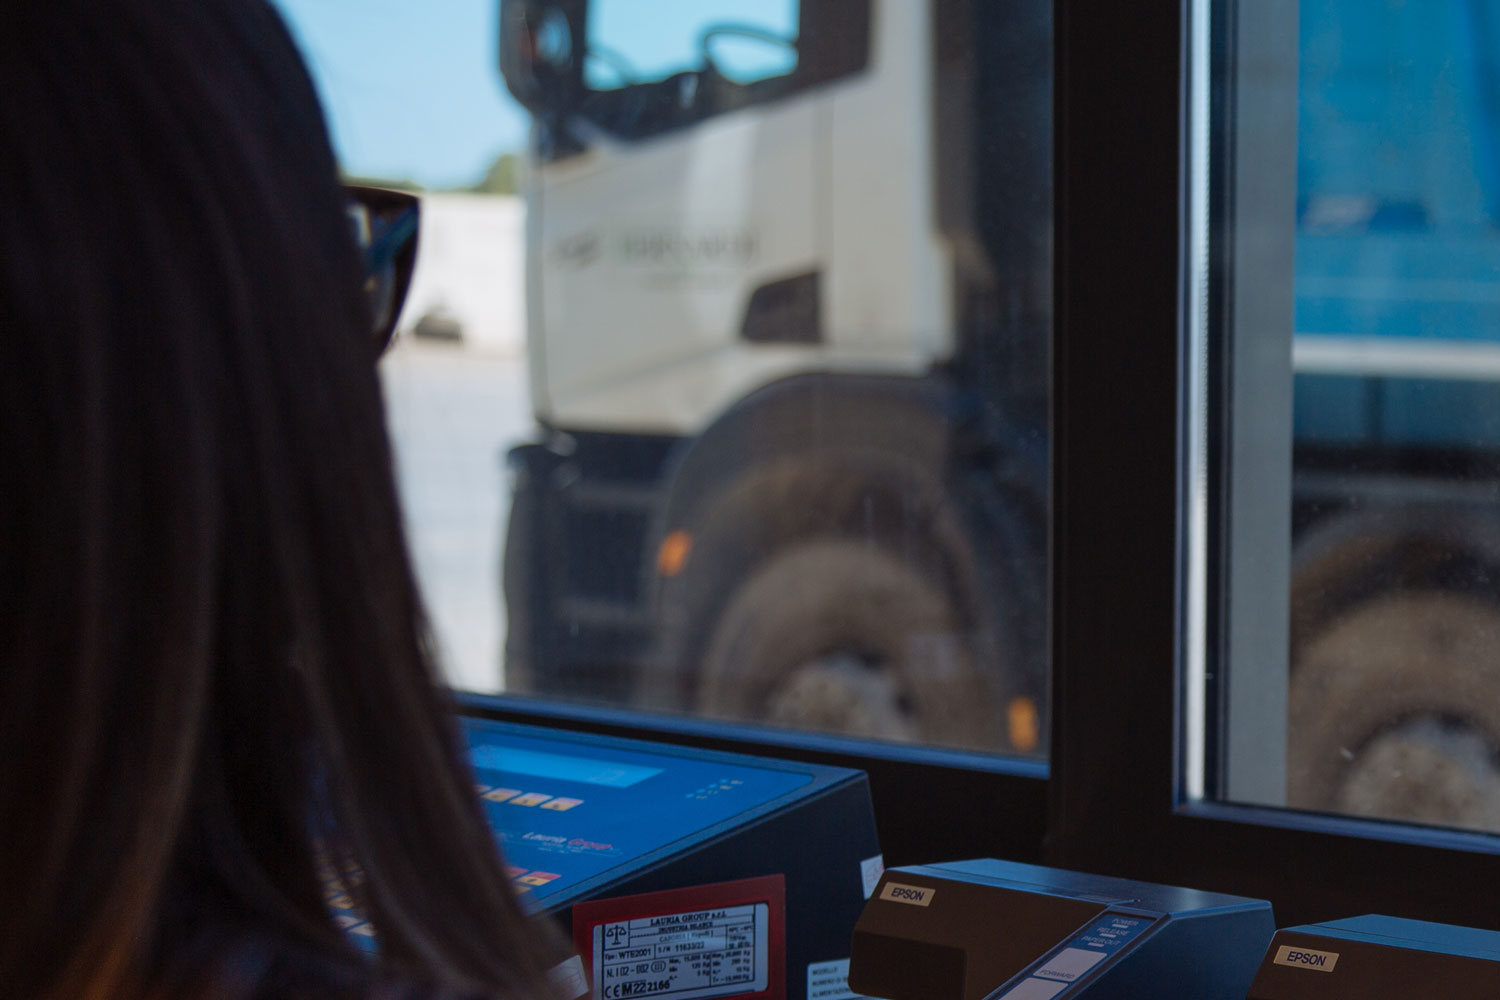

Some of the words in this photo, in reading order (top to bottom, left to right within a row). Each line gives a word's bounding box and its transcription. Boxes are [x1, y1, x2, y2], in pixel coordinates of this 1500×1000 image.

[890, 887, 925, 902] EPSON
[650, 915, 680, 927] LAURIA
[681, 912, 710, 923] GROUP
[1096, 927, 1129, 936] RELEASE
[1286, 951, 1327, 967] EPSON
[647, 979, 670, 992] 2166
